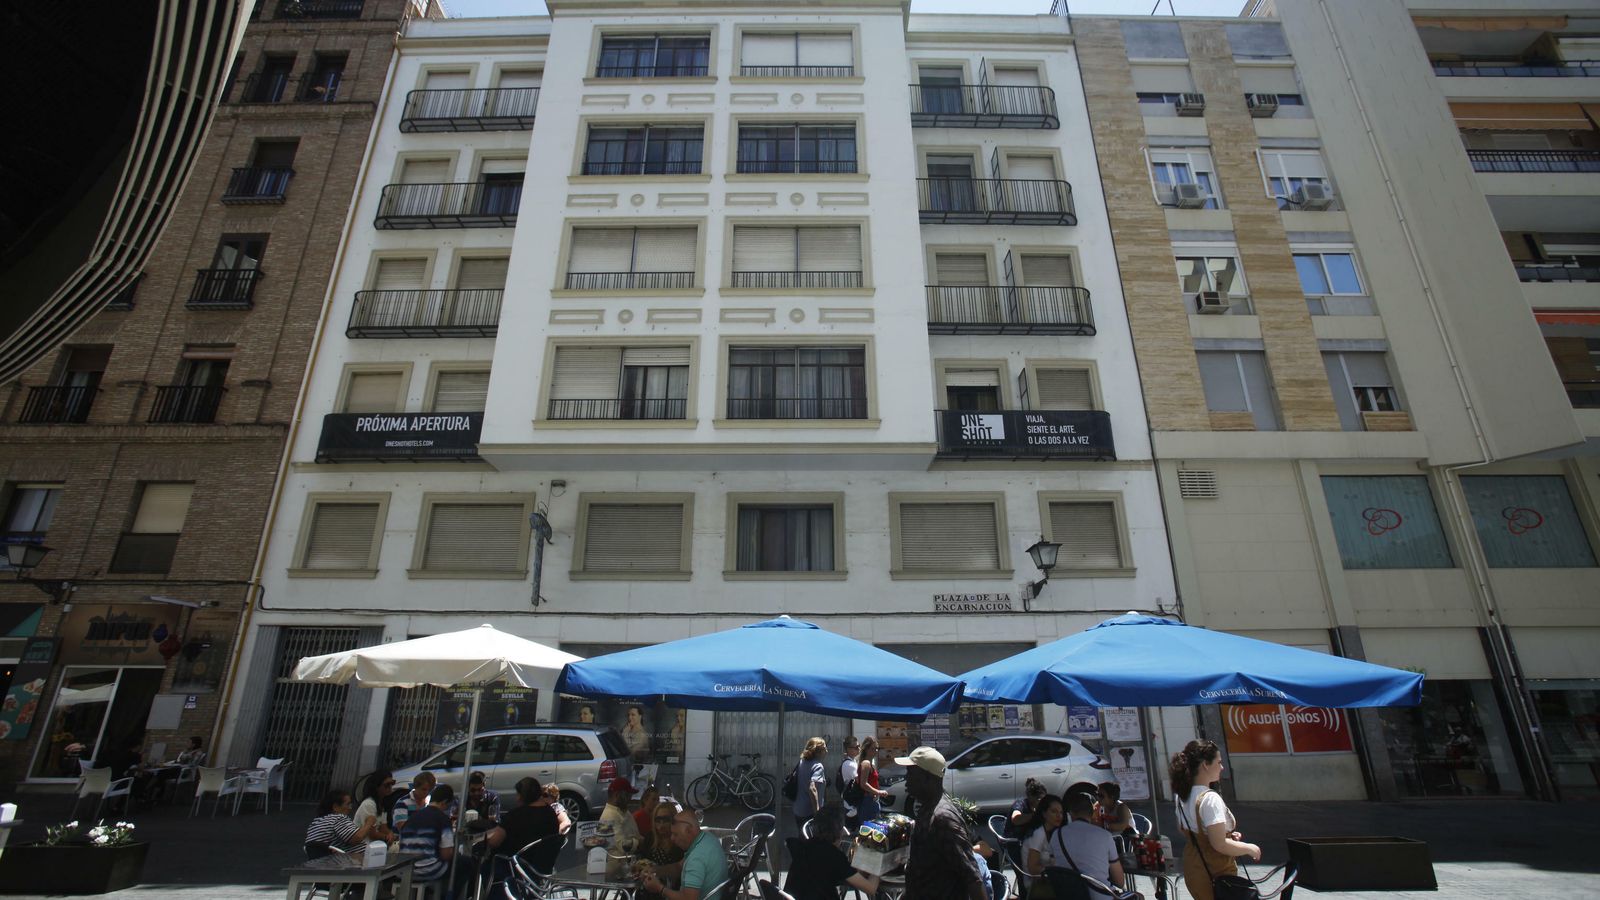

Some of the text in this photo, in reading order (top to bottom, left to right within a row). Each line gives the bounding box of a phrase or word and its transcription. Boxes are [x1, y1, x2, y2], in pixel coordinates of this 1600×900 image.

[355, 413, 471, 432] PRÓXIMA APERTURA
[961, 414, 985, 427] ONE
[962, 427, 992, 440] SHOT
[1027, 425, 1049, 434] SIENTE
[1049, 425, 1058, 434] EL
[1028, 435, 1090, 445] O LAS DOS A LA VEZ
[934, 594, 969, 602] PLAZA
[996, 593, 1011, 601] LA
[1248, 711, 1321, 725] AUDÍFONOS
